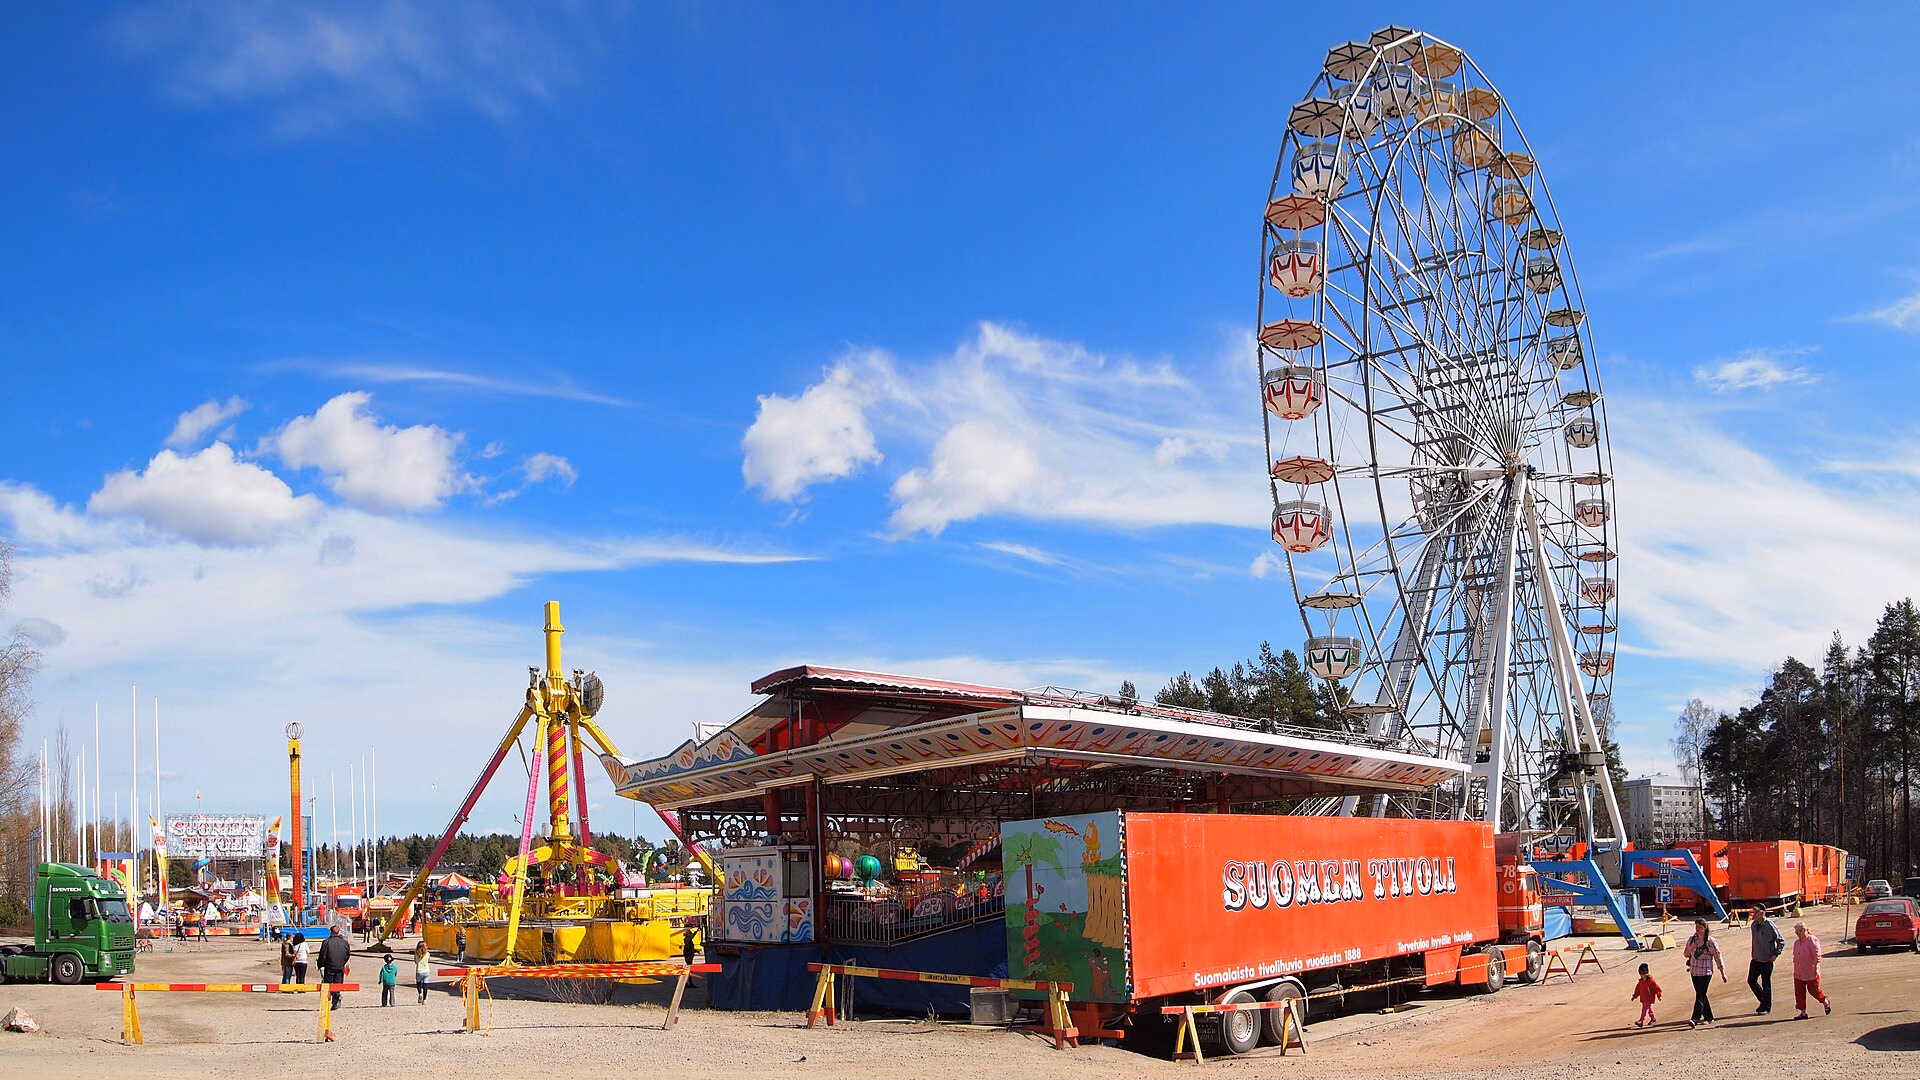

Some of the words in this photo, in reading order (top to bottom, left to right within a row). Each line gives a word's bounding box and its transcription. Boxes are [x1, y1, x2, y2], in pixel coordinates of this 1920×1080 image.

[174, 821, 258, 837] SUOMEN
[181, 837, 251, 852] TIVOLI
[1503, 865, 1515, 878] 78
[1222, 860, 1364, 912] SUOMEN
[1368, 856, 1458, 901] TIVOLI
[1397, 938, 1430, 953] Tervetuloa
[1194, 966, 1255, 987] Suomalaista
[1258, 957, 1303, 976] tivolihuvia
[1305, 951, 1343, 968] vuodesta
[1344, 947, 1362, 961] 1888
